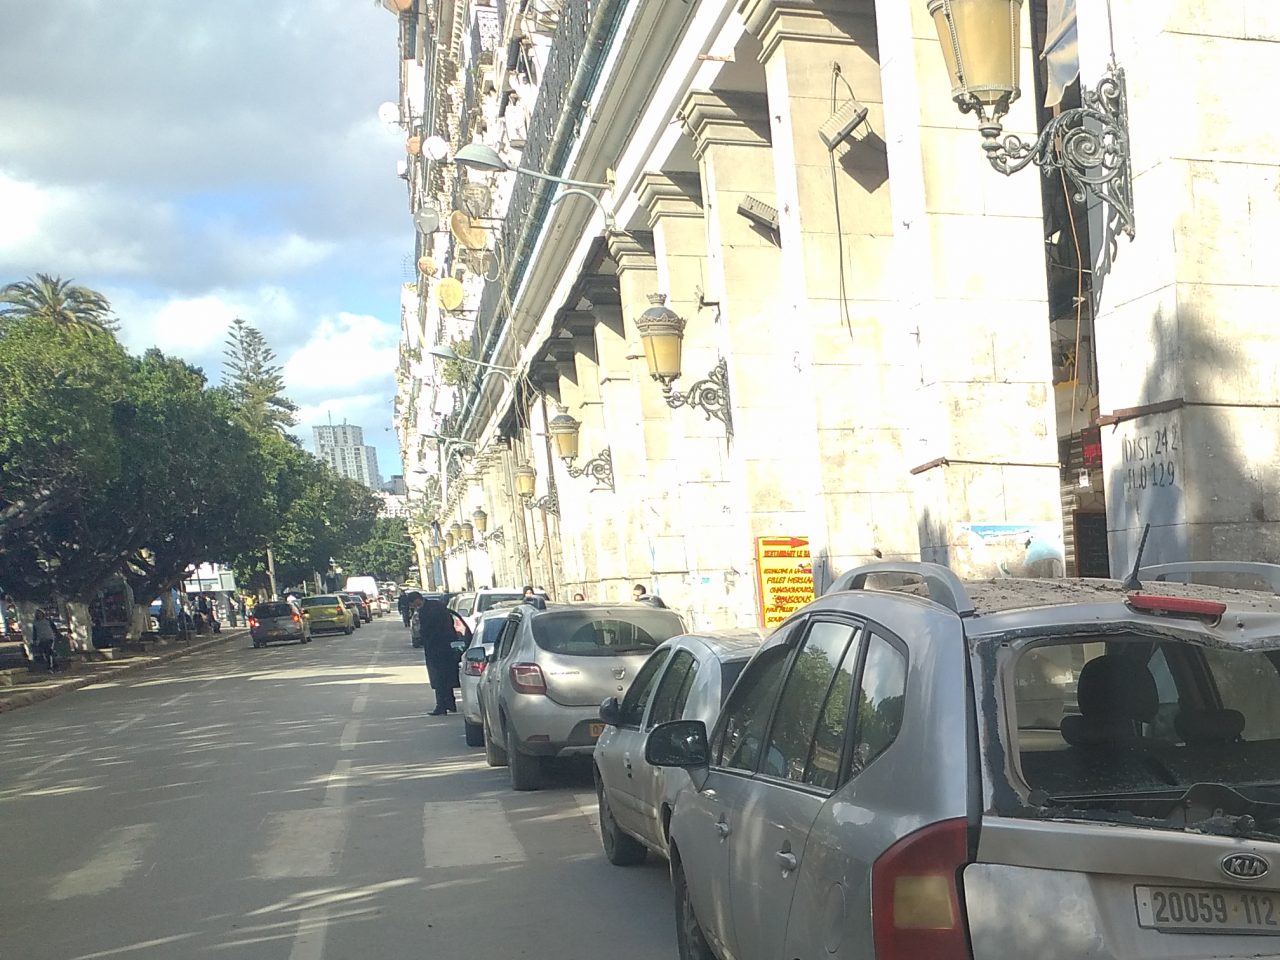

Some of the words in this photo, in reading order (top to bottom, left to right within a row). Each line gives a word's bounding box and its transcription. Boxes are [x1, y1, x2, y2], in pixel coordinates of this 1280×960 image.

[1150, 460, 1175, 488] 129
[1228, 856, 1266, 876] KIA
[1152, 890, 1228, 924] 20059
[1240, 893, 1278, 926] 112
